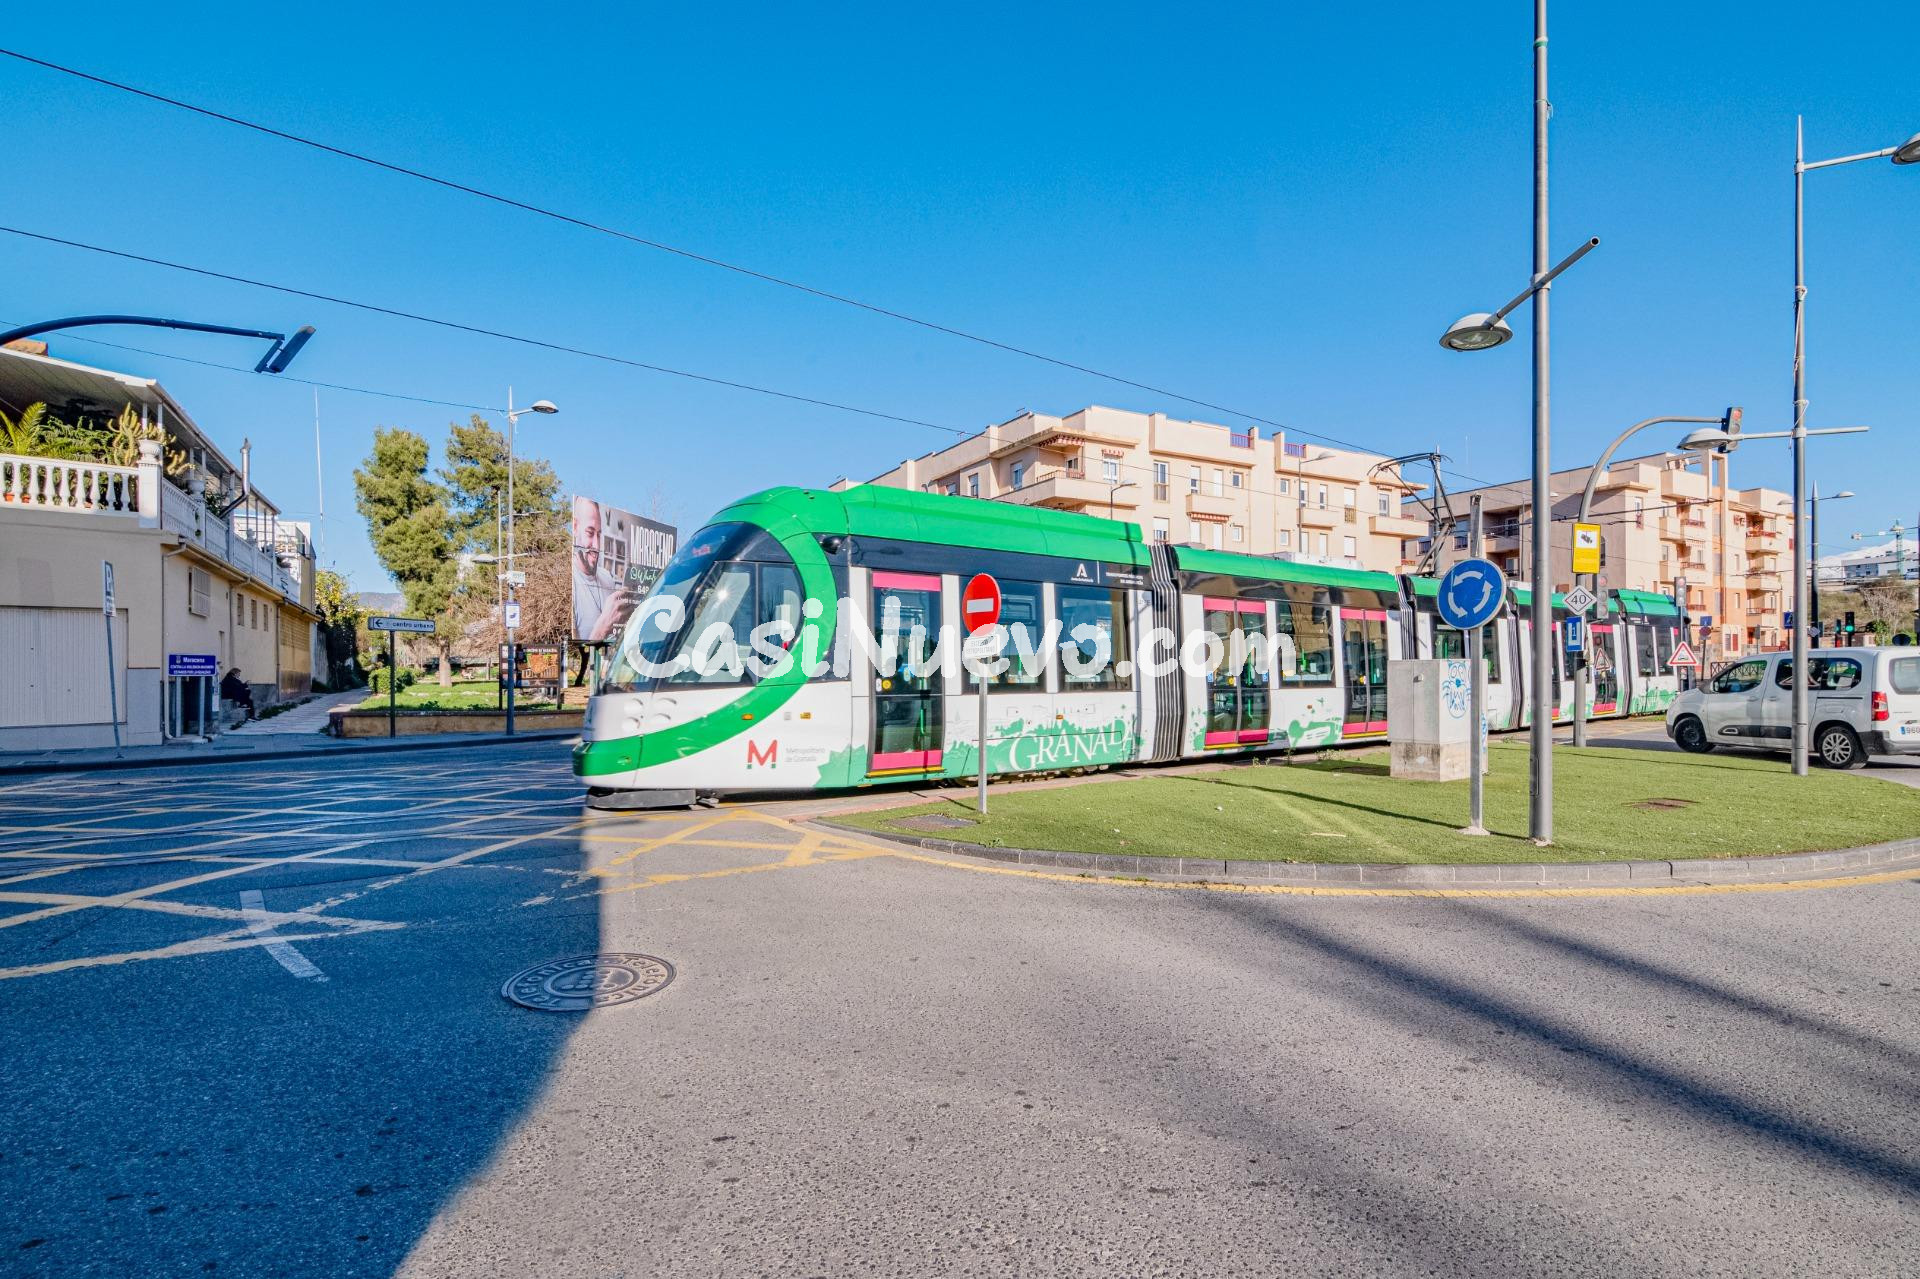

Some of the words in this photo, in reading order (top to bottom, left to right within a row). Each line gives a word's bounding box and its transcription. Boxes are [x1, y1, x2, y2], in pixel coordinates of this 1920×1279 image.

[1570, 594, 1587, 605] 40
[747, 739, 778, 769] M
[1009, 719, 1137, 772] GRANADA
